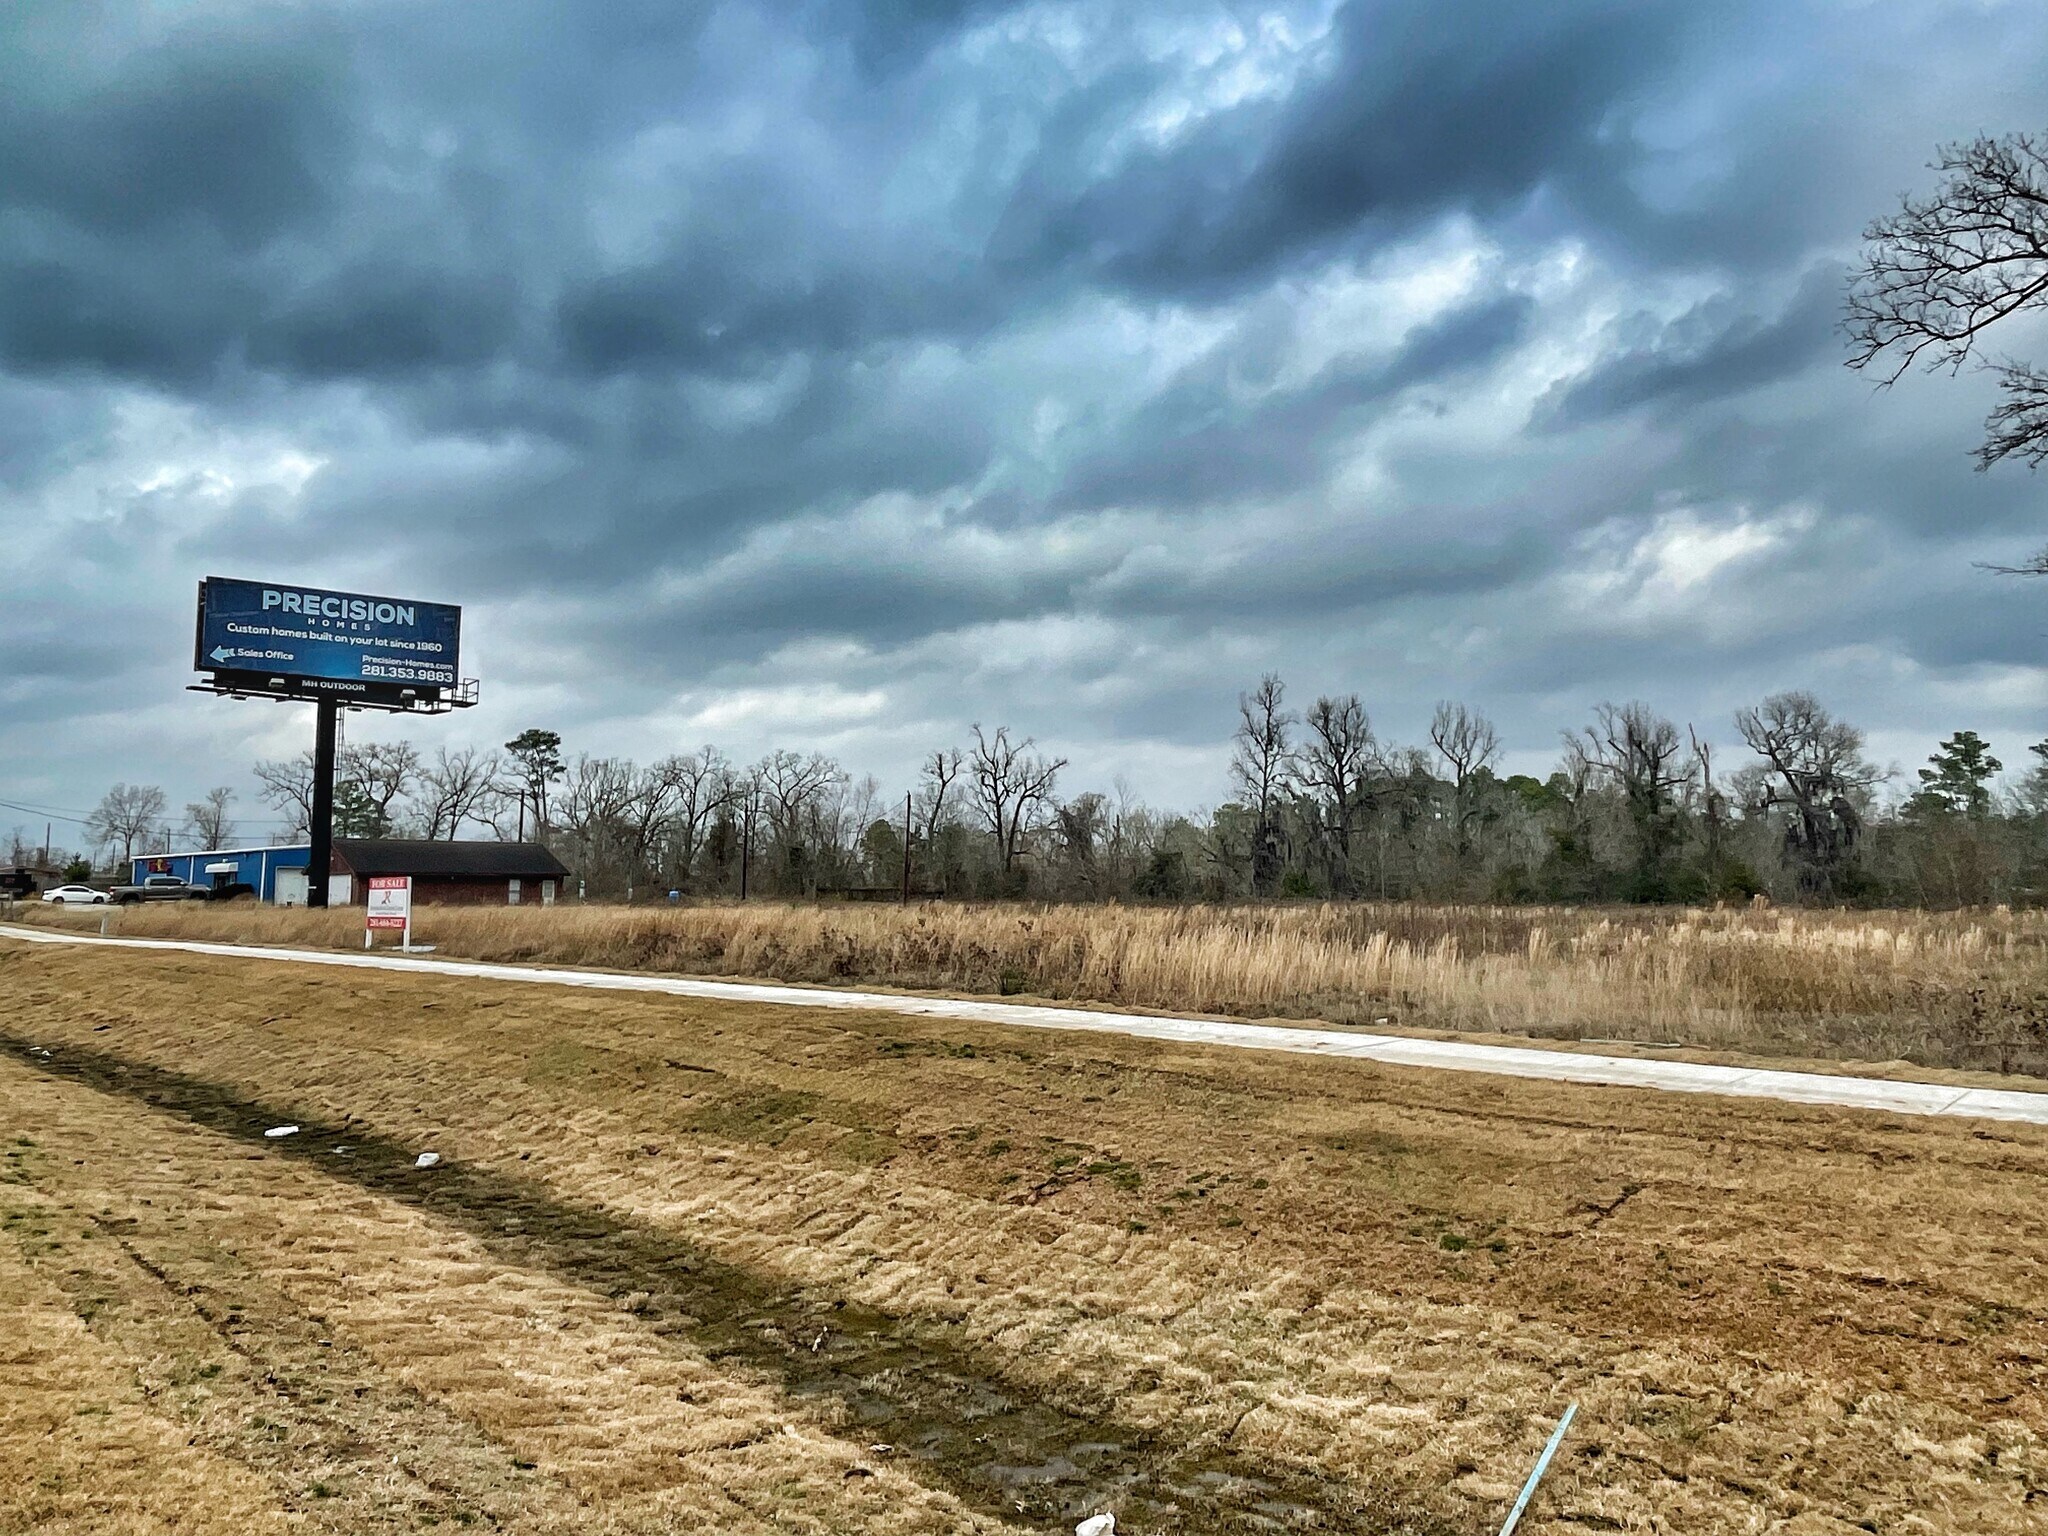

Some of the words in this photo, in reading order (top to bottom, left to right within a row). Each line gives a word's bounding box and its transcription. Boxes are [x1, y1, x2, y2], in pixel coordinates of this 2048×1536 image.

[262, 589, 415, 626] PRECISION
[308, 617, 371, 631] HOMES
[227, 622, 270, 635] Custom
[271, 626, 308, 639] homes
[309, 630, 333, 641] built
[334, 635, 348, 643] on
[349, 636, 374, 646] your
[375, 637, 388, 647] lot
[390, 640, 415, 649] since
[416, 641, 443, 652] 1960
[237, 648, 264, 658] Sales
[265, 650, 294, 661] Office
[362, 654, 454, 671] Precision-Homes.com
[361, 664, 454, 683] 281.353.9883
[301, 680, 318, 689] MH
[320, 681, 366, 692] OUTDOOR
[371, 880, 386, 888] FOR
[386, 879, 405, 888] SALE
